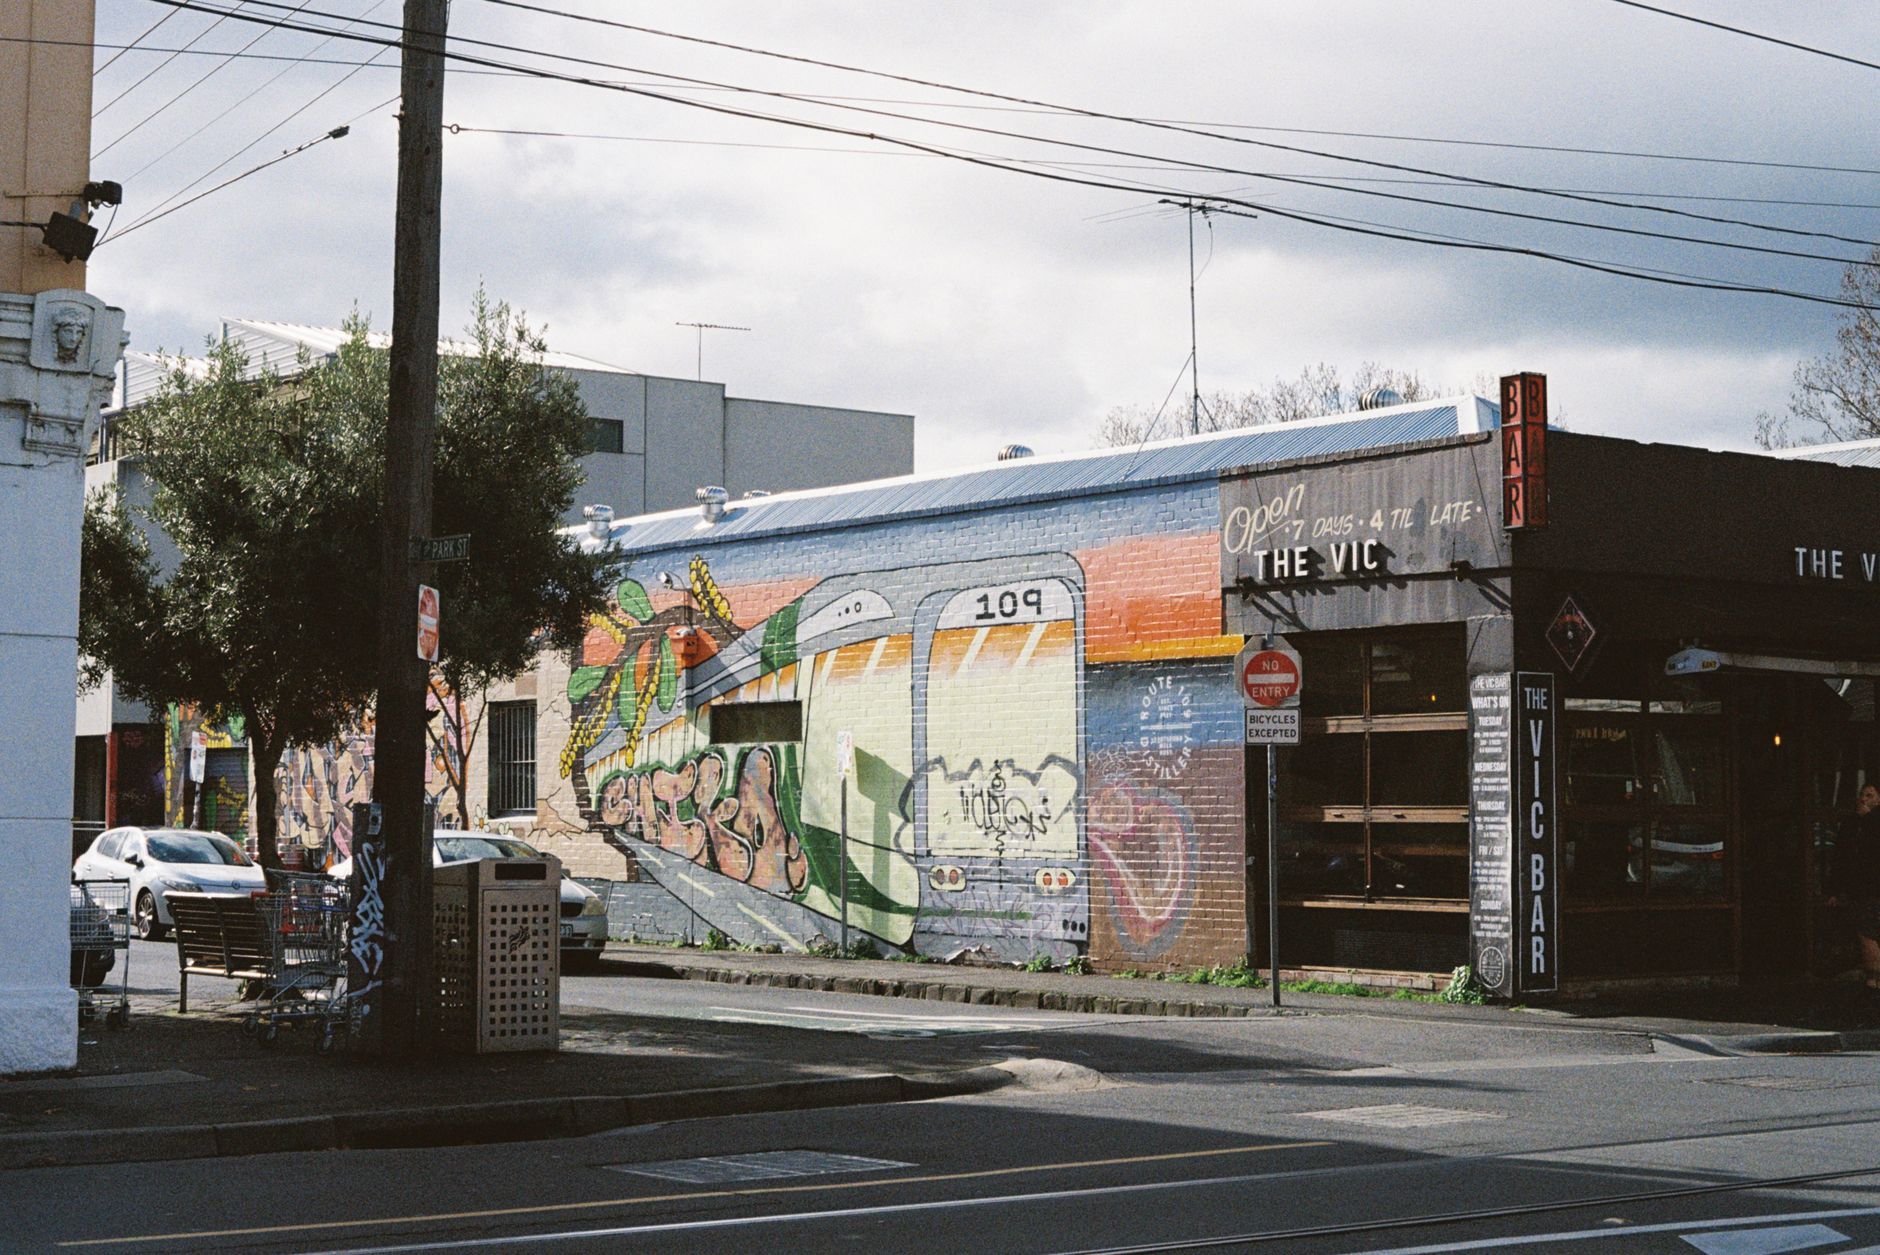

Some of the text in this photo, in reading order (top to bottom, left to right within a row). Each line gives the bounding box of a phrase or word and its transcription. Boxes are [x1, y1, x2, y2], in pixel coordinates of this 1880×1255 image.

[1505, 381, 1521, 524] BAR
[1224, 483, 1304, 554] Open
[1312, 514, 1353, 538] DAYS
[1369, 509, 1384, 532] 4
[1390, 507, 1414, 530] TIL
[1430, 500, 1473, 526] LATE
[432, 537, 467, 560] PARK ST
[1253, 538, 1378, 580] THE VIC
[1794, 546, 1844, 580] THE
[975, 588, 1042, 620] 109
[1262, 660, 1279, 671] NO
[1252, 686, 1290, 698] ENTRY
[1495, 677, 1507, 688] BAR
[1140, 675, 1172, 720] ROUTE
[1472, 695, 1509, 709] WHAT'S ON
[1524, 687, 1548, 710] THE
[1249, 715, 1296, 724] BICYCLES
[1478, 716, 1503, 726] TUESDAY
[1248, 729, 1297, 738] EXCEPTED
[1140, 734, 1193, 779] DISTILLERY
[1474, 762, 1507, 772] WEDNESDAY
[1530, 720, 1544, 839] VIC
[1477, 801, 1505, 811] THURSDAY
[1480, 900, 1503, 910] SUNDAY
[1531, 854, 1545, 974] BAR
